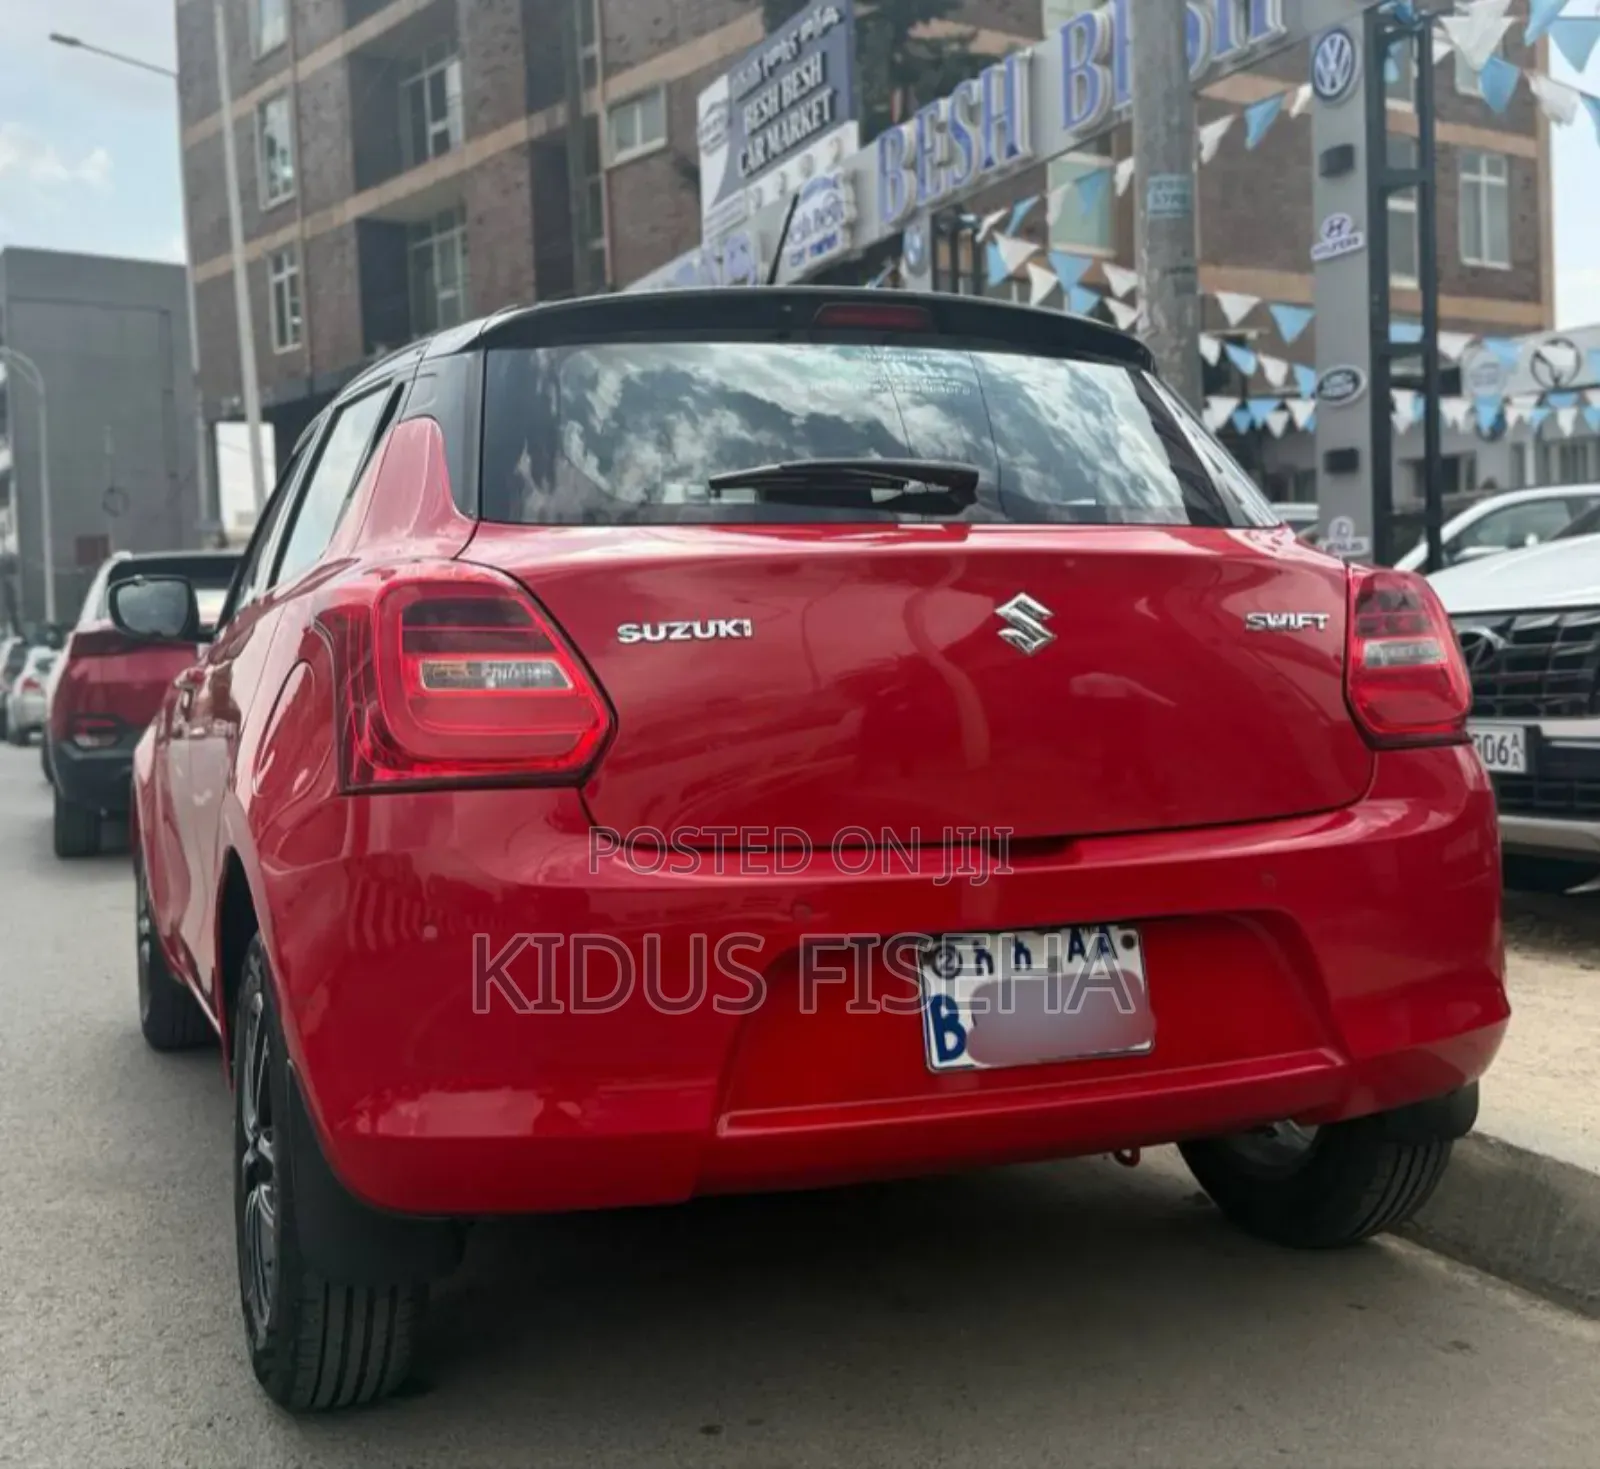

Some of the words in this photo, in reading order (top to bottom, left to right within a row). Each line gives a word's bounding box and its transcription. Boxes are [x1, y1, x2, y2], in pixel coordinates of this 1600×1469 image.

[744, 82, 780, 135] BESH
[782, 51, 823, 108] BESH
[738, 134, 765, 178] CAR
[767, 87, 834, 161] MARKET
[877, 47, 1032, 225] BESH
[617, 618, 753, 645] SUZUKI
[1245, 612, 1331, 632] SWIFT
[929, 994, 967, 1063] B
